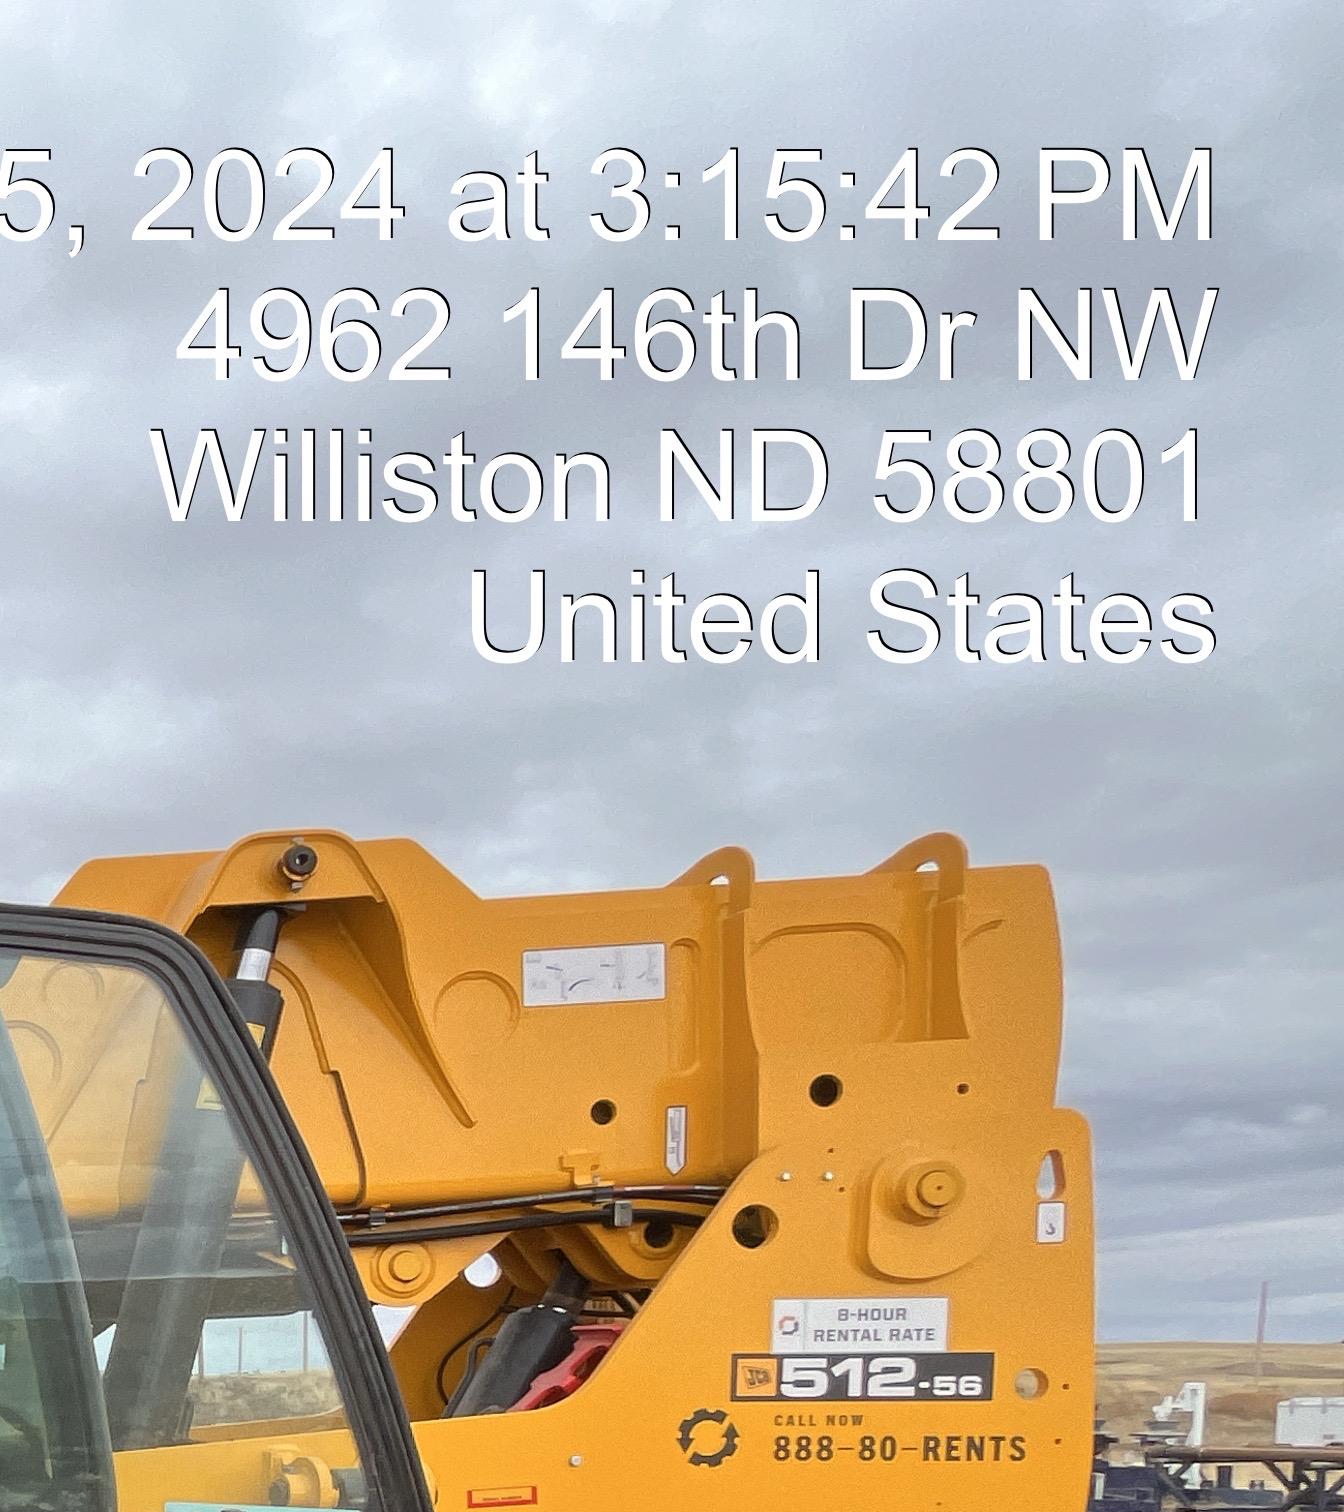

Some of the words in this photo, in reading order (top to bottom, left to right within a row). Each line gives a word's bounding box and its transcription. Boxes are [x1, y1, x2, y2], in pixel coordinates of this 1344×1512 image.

[837, 1307, 908, 1323] 8-HOUR
[813, 1328, 884, 1343] RENTAL
[889, 1327, 936, 1342] RATE
[773, 1414, 817, 1427] CALL
[825, 1414, 864, 1427] NOW
[773, 1435, 1027, 1462] 888-80-RENTS
